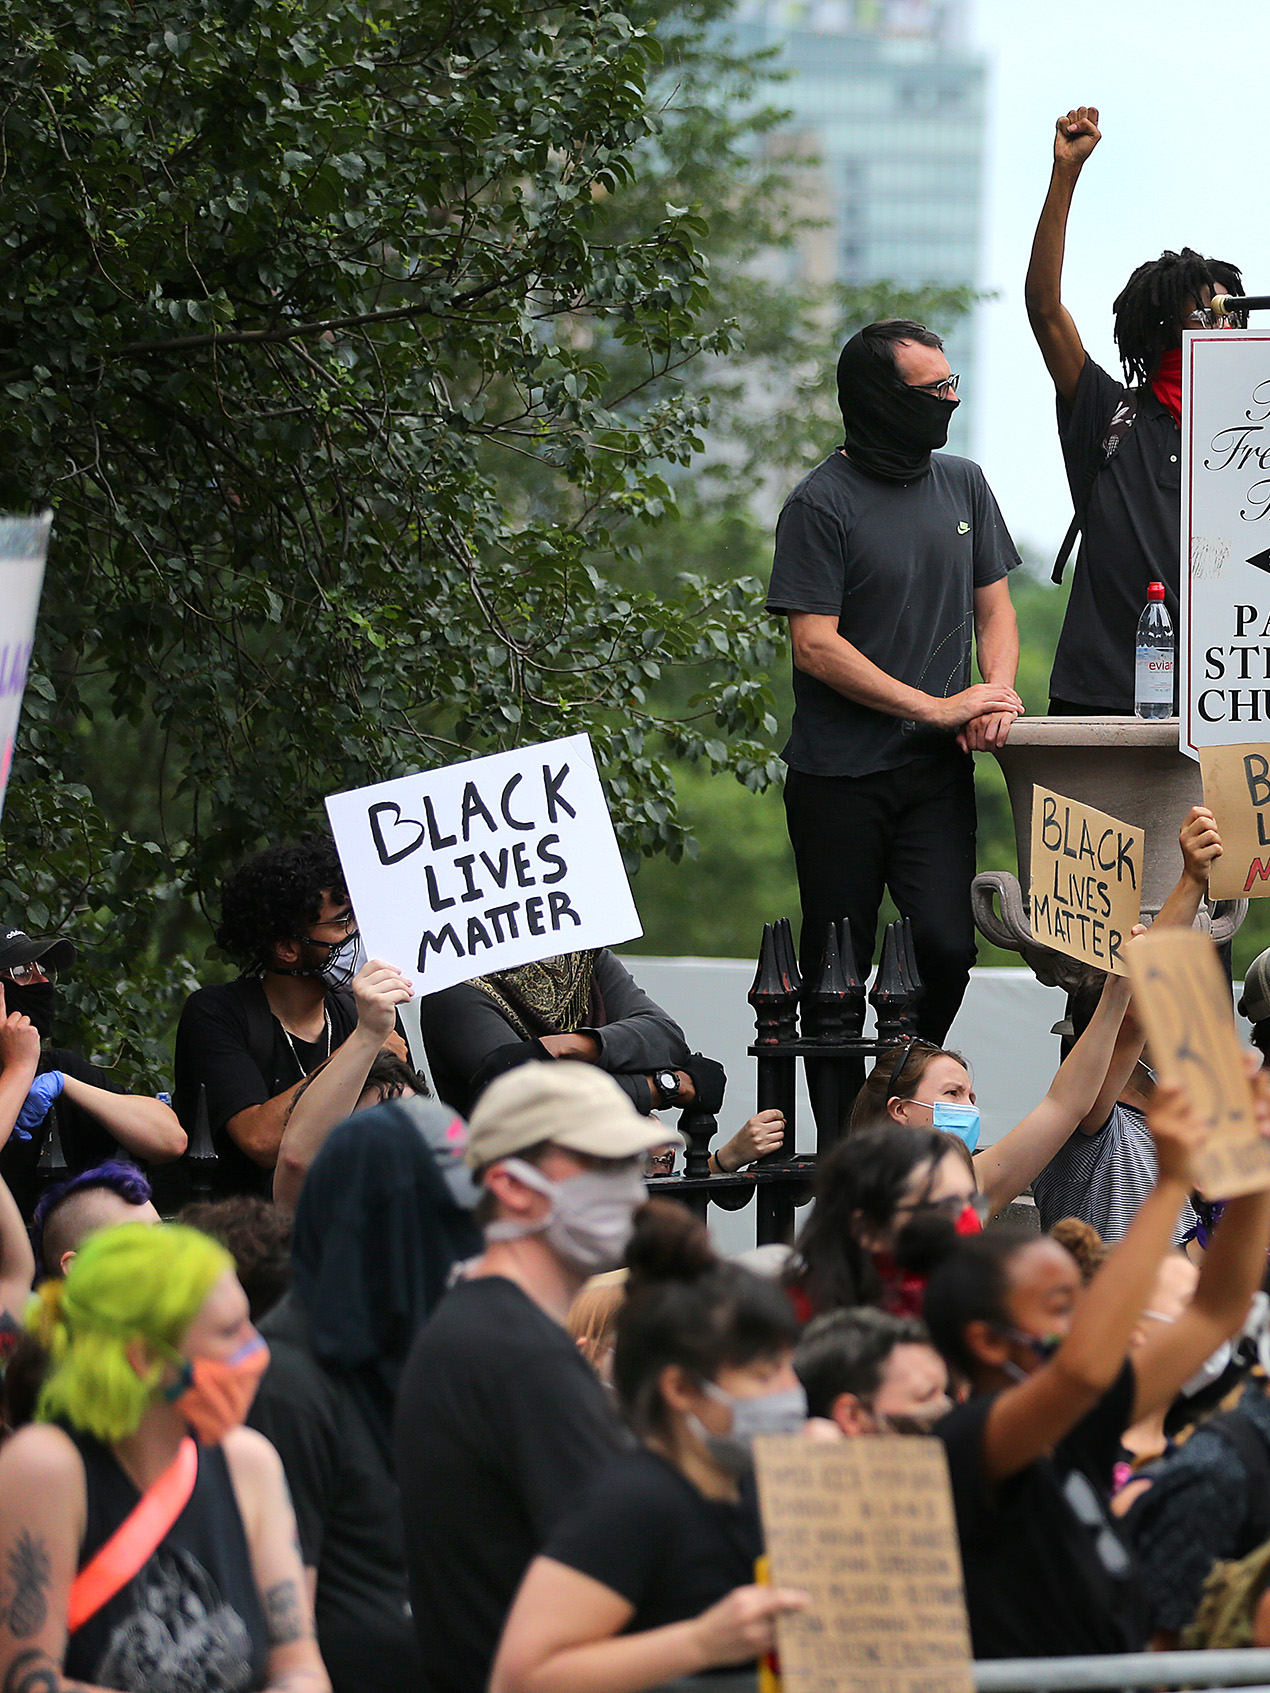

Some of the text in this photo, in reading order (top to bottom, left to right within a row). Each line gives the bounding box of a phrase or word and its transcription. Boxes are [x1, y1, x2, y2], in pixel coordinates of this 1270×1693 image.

[368, 763, 577, 866] BLACK
[1041, 797, 1137, 891] BLACK
[424, 833, 568, 912] LIVES
[1053, 860, 1112, 919] LIVES
[416, 890, 582, 973] MATTER
[1034, 894, 1128, 969] MATTER
